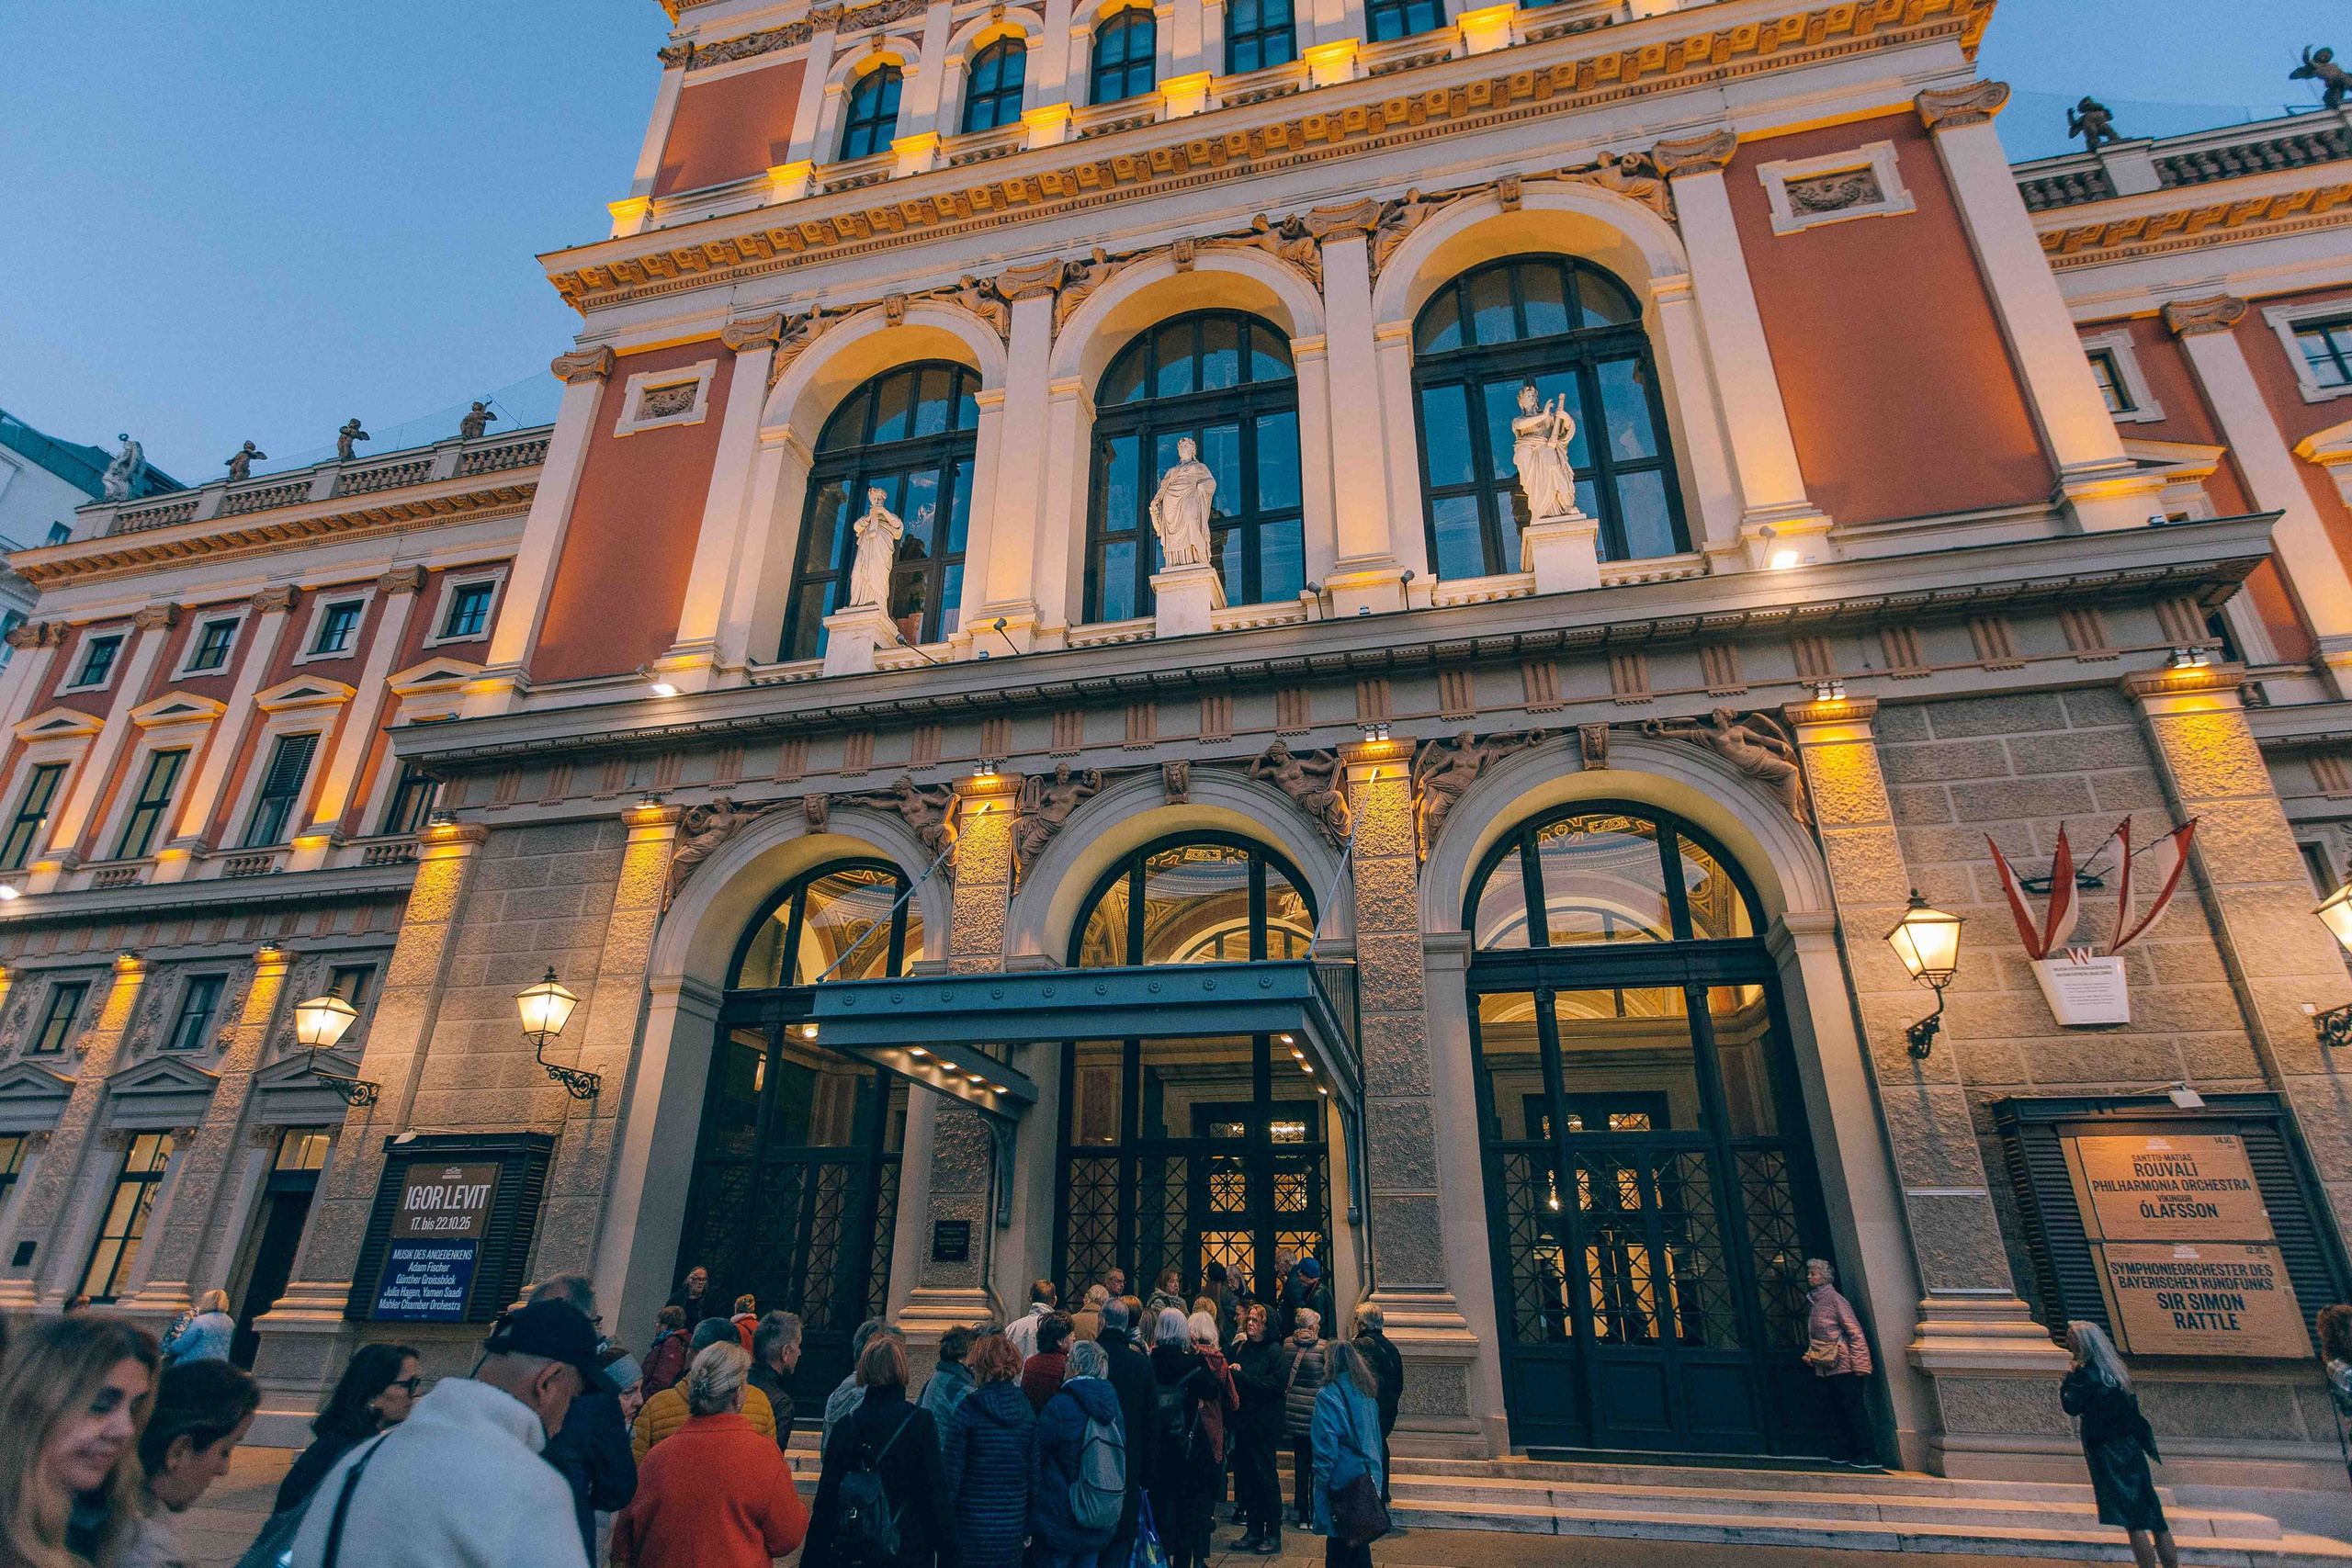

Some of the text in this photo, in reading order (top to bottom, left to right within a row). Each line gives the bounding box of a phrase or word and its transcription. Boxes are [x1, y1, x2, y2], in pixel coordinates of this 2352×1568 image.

[2133, 1163, 2199, 1177] ROUVALI
[2092, 1179, 2251, 1192] PHILHARMONIA ORCHESTRA
[404, 1185, 491, 1210] IGOR LEVIT
[2140, 1200, 2219, 1218] ÓLAFSSON
[411, 1216, 471, 1230] 17. bis 22.10.25
[392, 1249, 473, 1260] MUSIK DES ANGEDENKENS
[408, 1261, 450, 1272] Adam Fischer
[2110, 1262, 2274, 1277] SYMPHONIEORCHESTER DES
[395, 1273, 457, 1285] Günther Groissböck
[2118, 1276, 2274, 1292] BAYERISCHEN RUNDFUNKS
[383, 1286, 463, 1299] Julia Hagen, Yamen Saadi
[379, 1298, 461, 1311] Mahler Chamber Orchestra
[2156, 1292, 2245, 1312] SIR SIMON
[2173, 1312, 2241, 1331] RATTLE
